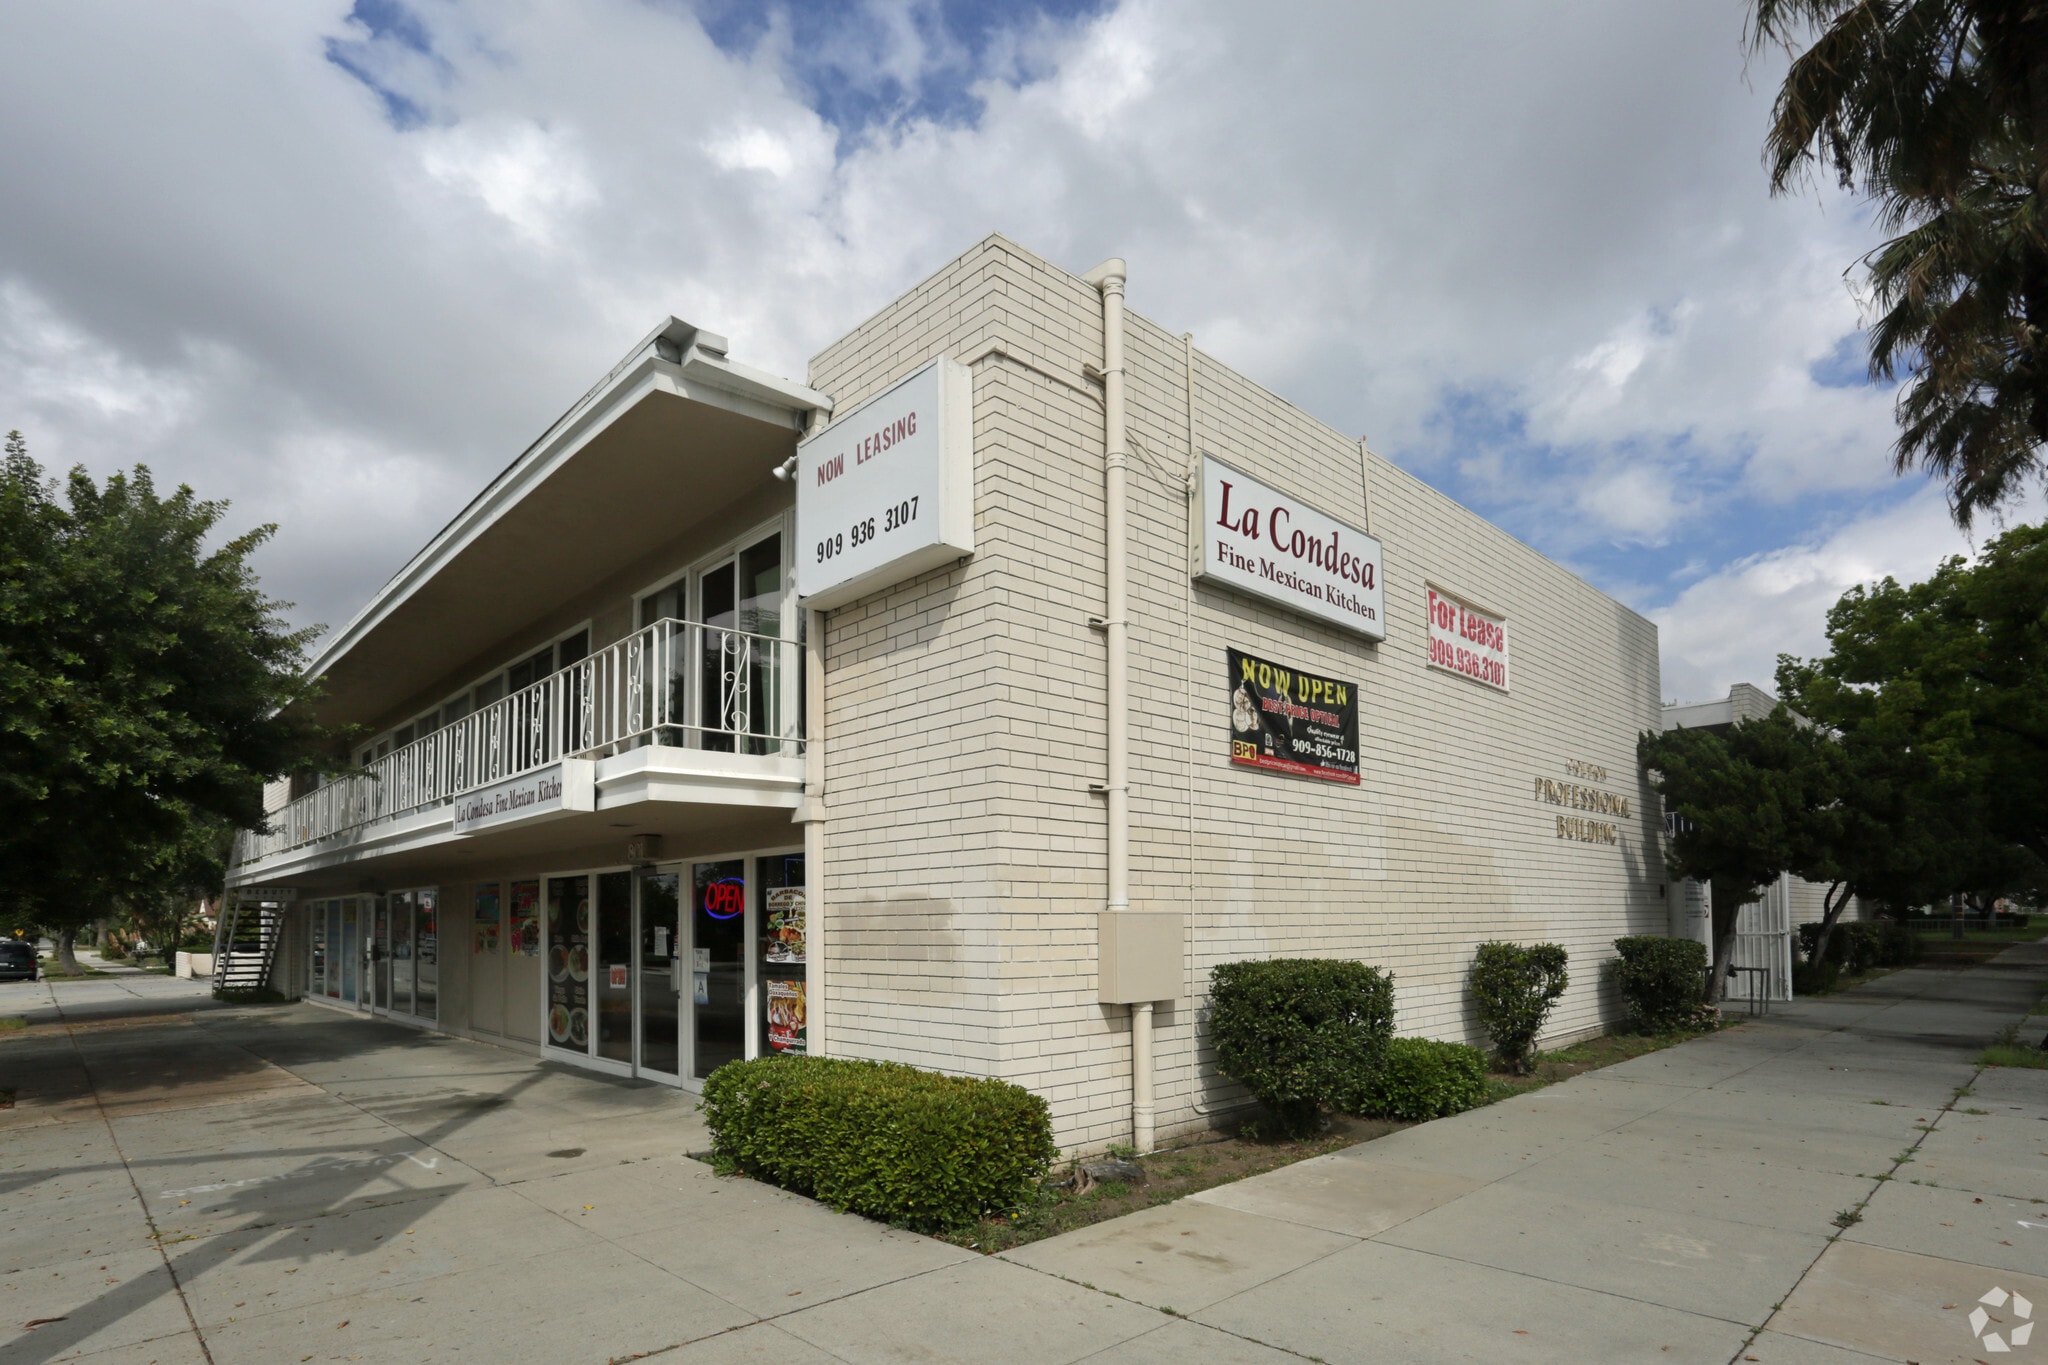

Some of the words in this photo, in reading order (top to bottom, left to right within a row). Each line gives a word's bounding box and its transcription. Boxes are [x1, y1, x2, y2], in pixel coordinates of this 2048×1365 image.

[817, 453, 844, 487] NOW
[856, 411, 917, 466] LEASING
[817, 533, 843, 564] 909
[851, 517, 875, 548] 936
[884, 495, 919, 532] 3107
[1216, 480, 1260, 540] La
[1269, 506, 1375, 590] Condesa
[1216, 540, 1256, 574] Fine
[1259, 557, 1322, 600] Mexican
[1325, 583, 1376, 621] Kitchen
[1428, 589, 1456, 633] For
[1459, 606, 1504, 653] Lease
[1241, 657, 1291, 697] NOW
[1298, 675, 1347, 706] OPEN
[1429, 635, 1505, 687] 909.936.3107
[1262, 696, 1284, 714] BEST
[1285, 703, 1309, 721] PRICE
[1310, 708, 1340, 728] OPTICAL
[1233, 741, 1256, 759] BPO
[1292, 738, 1356, 763] 909-856-1728
[457, 805, 466, 823] La
[466, 798, 493, 821] Condesa
[495, 793, 508, 814] Fine
[508, 787, 535, 811] Mexican
[1534, 777, 1631, 819] PROFESSIONAL
[1556, 815, 1617, 846] BUILDING
[705, 882, 744, 914] OPEN
